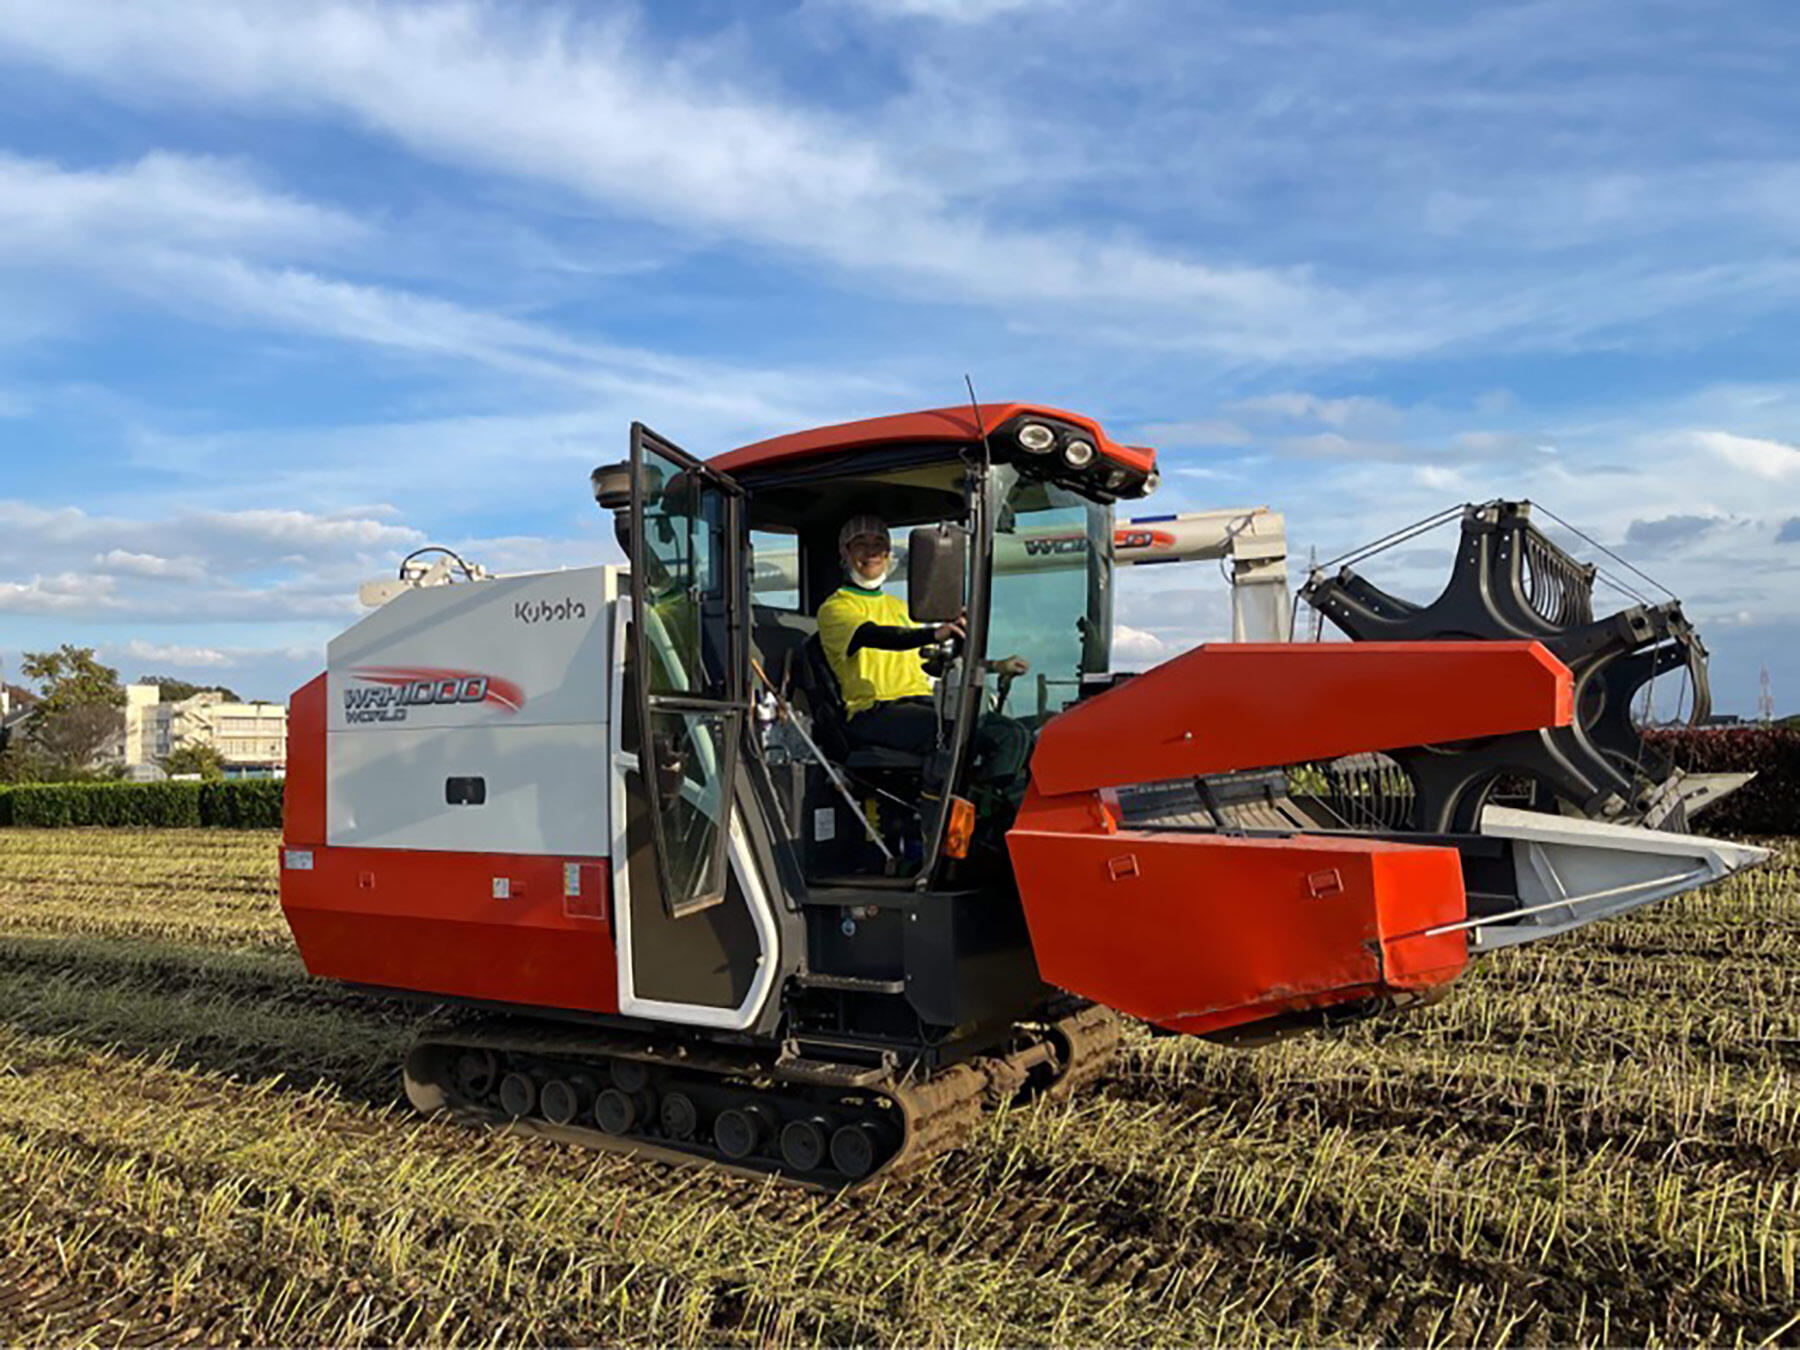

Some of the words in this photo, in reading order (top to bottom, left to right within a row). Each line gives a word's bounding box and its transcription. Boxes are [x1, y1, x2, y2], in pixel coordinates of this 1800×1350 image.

[515, 597, 586, 624] Kubota
[344, 677, 488, 708] WRH1000
[345, 709, 407, 724] WORLD
